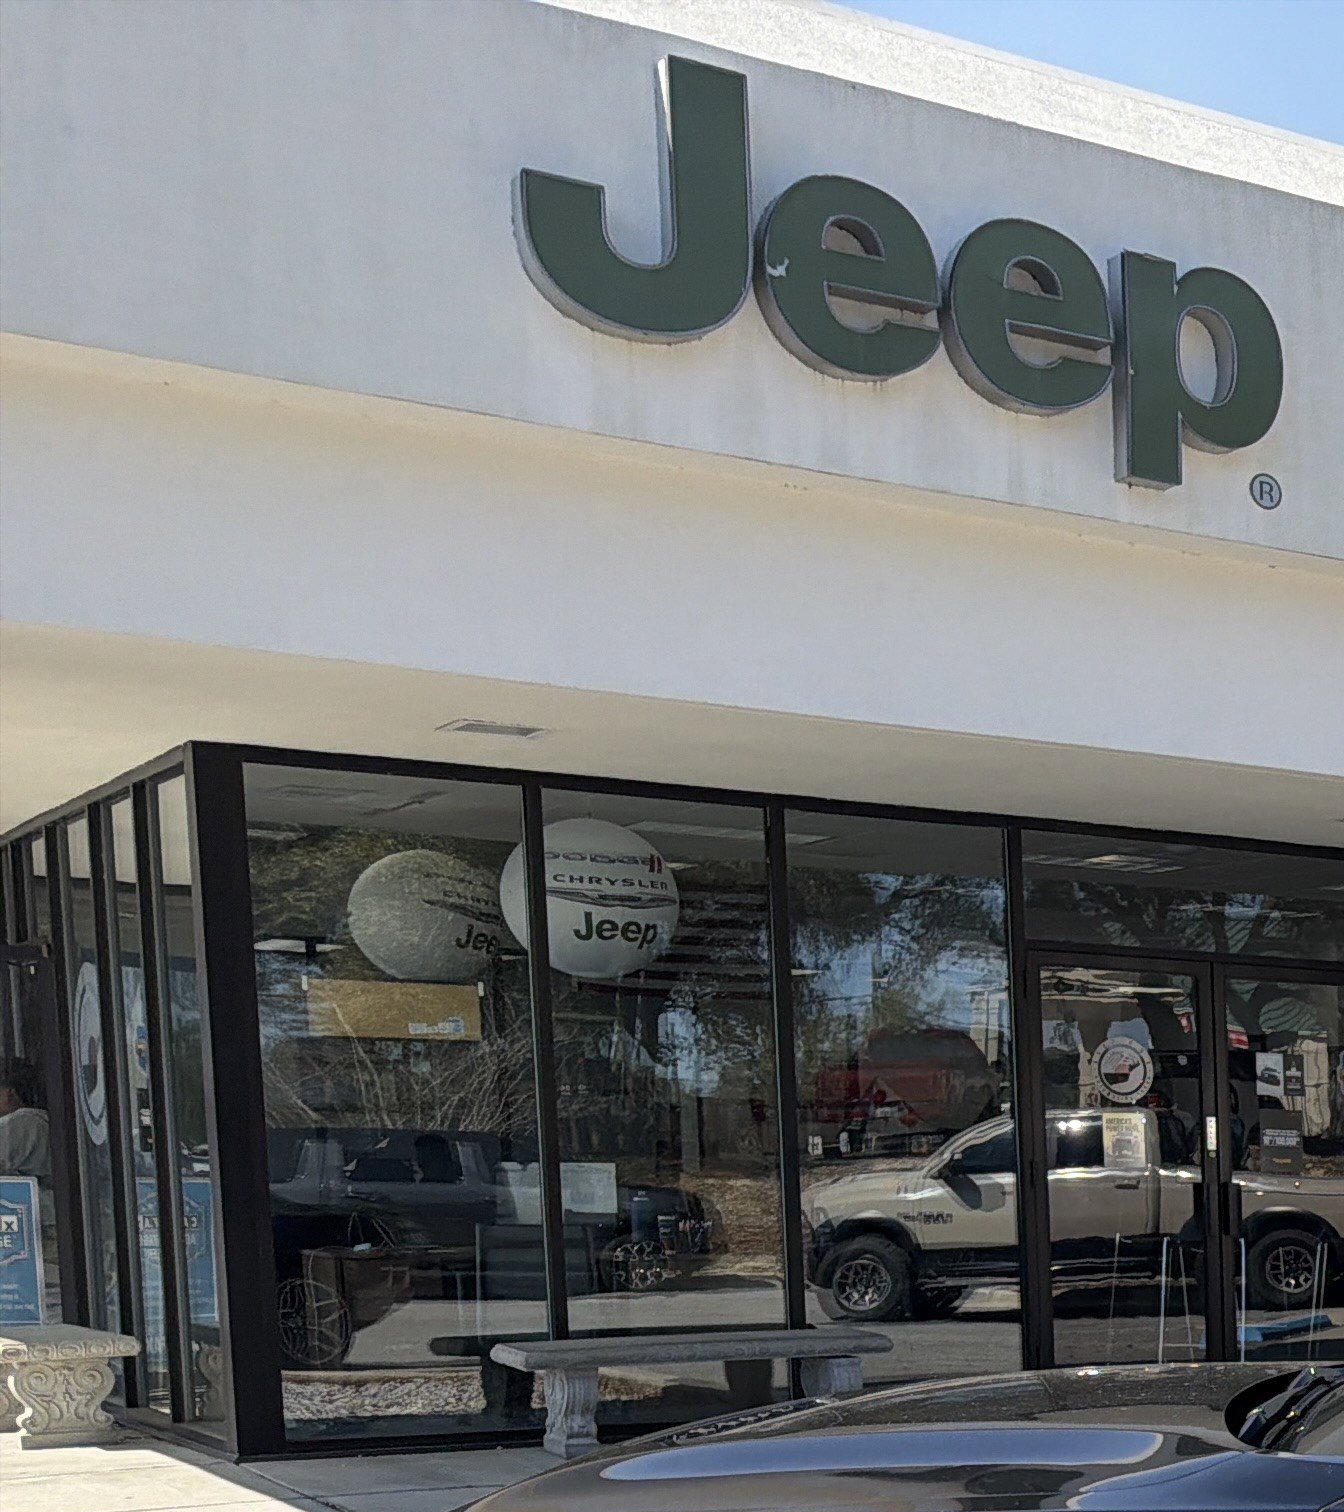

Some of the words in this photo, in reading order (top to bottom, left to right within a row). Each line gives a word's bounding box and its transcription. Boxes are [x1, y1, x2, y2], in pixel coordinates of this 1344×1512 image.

[512, 54, 1284, 490] Jeep
[553, 873, 668, 890] CHRYSLER
[573, 911, 659, 951] Jeep
